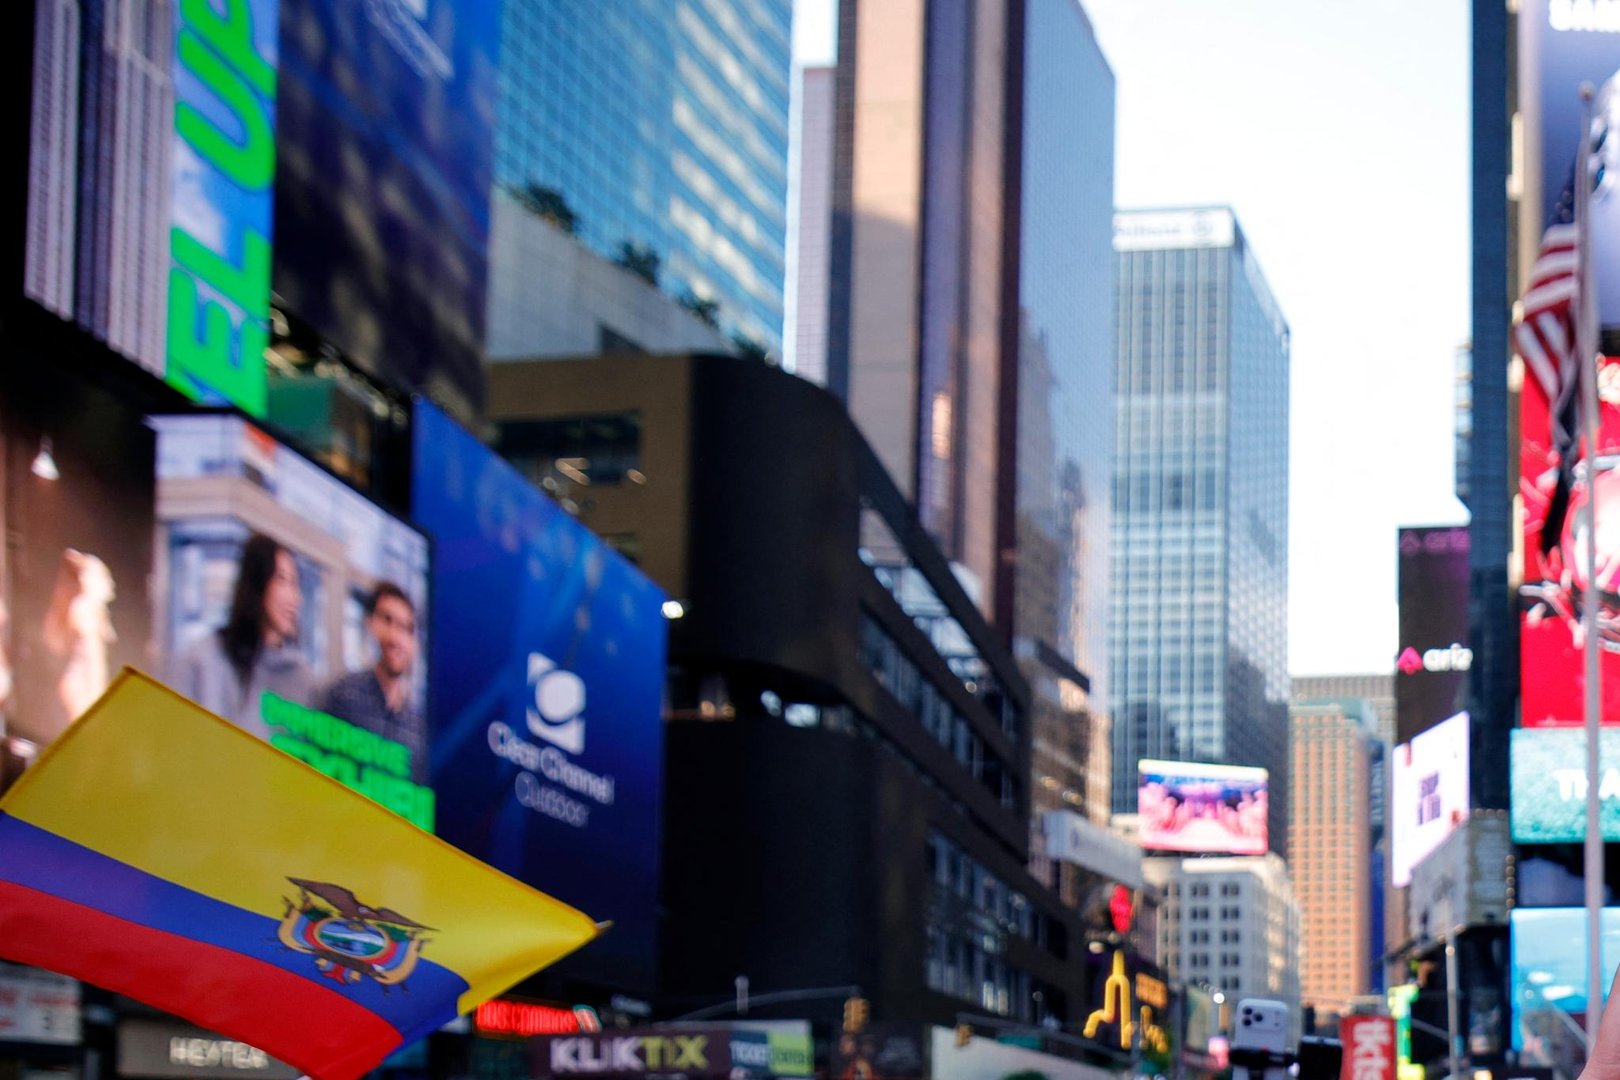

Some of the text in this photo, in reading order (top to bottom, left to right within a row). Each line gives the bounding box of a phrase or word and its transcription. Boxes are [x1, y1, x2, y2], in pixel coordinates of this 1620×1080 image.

[487, 720, 615, 805] Clear Channel
[514, 770, 590, 827] Outdoor
[549, 1035, 711, 1074] KLIKTIX
